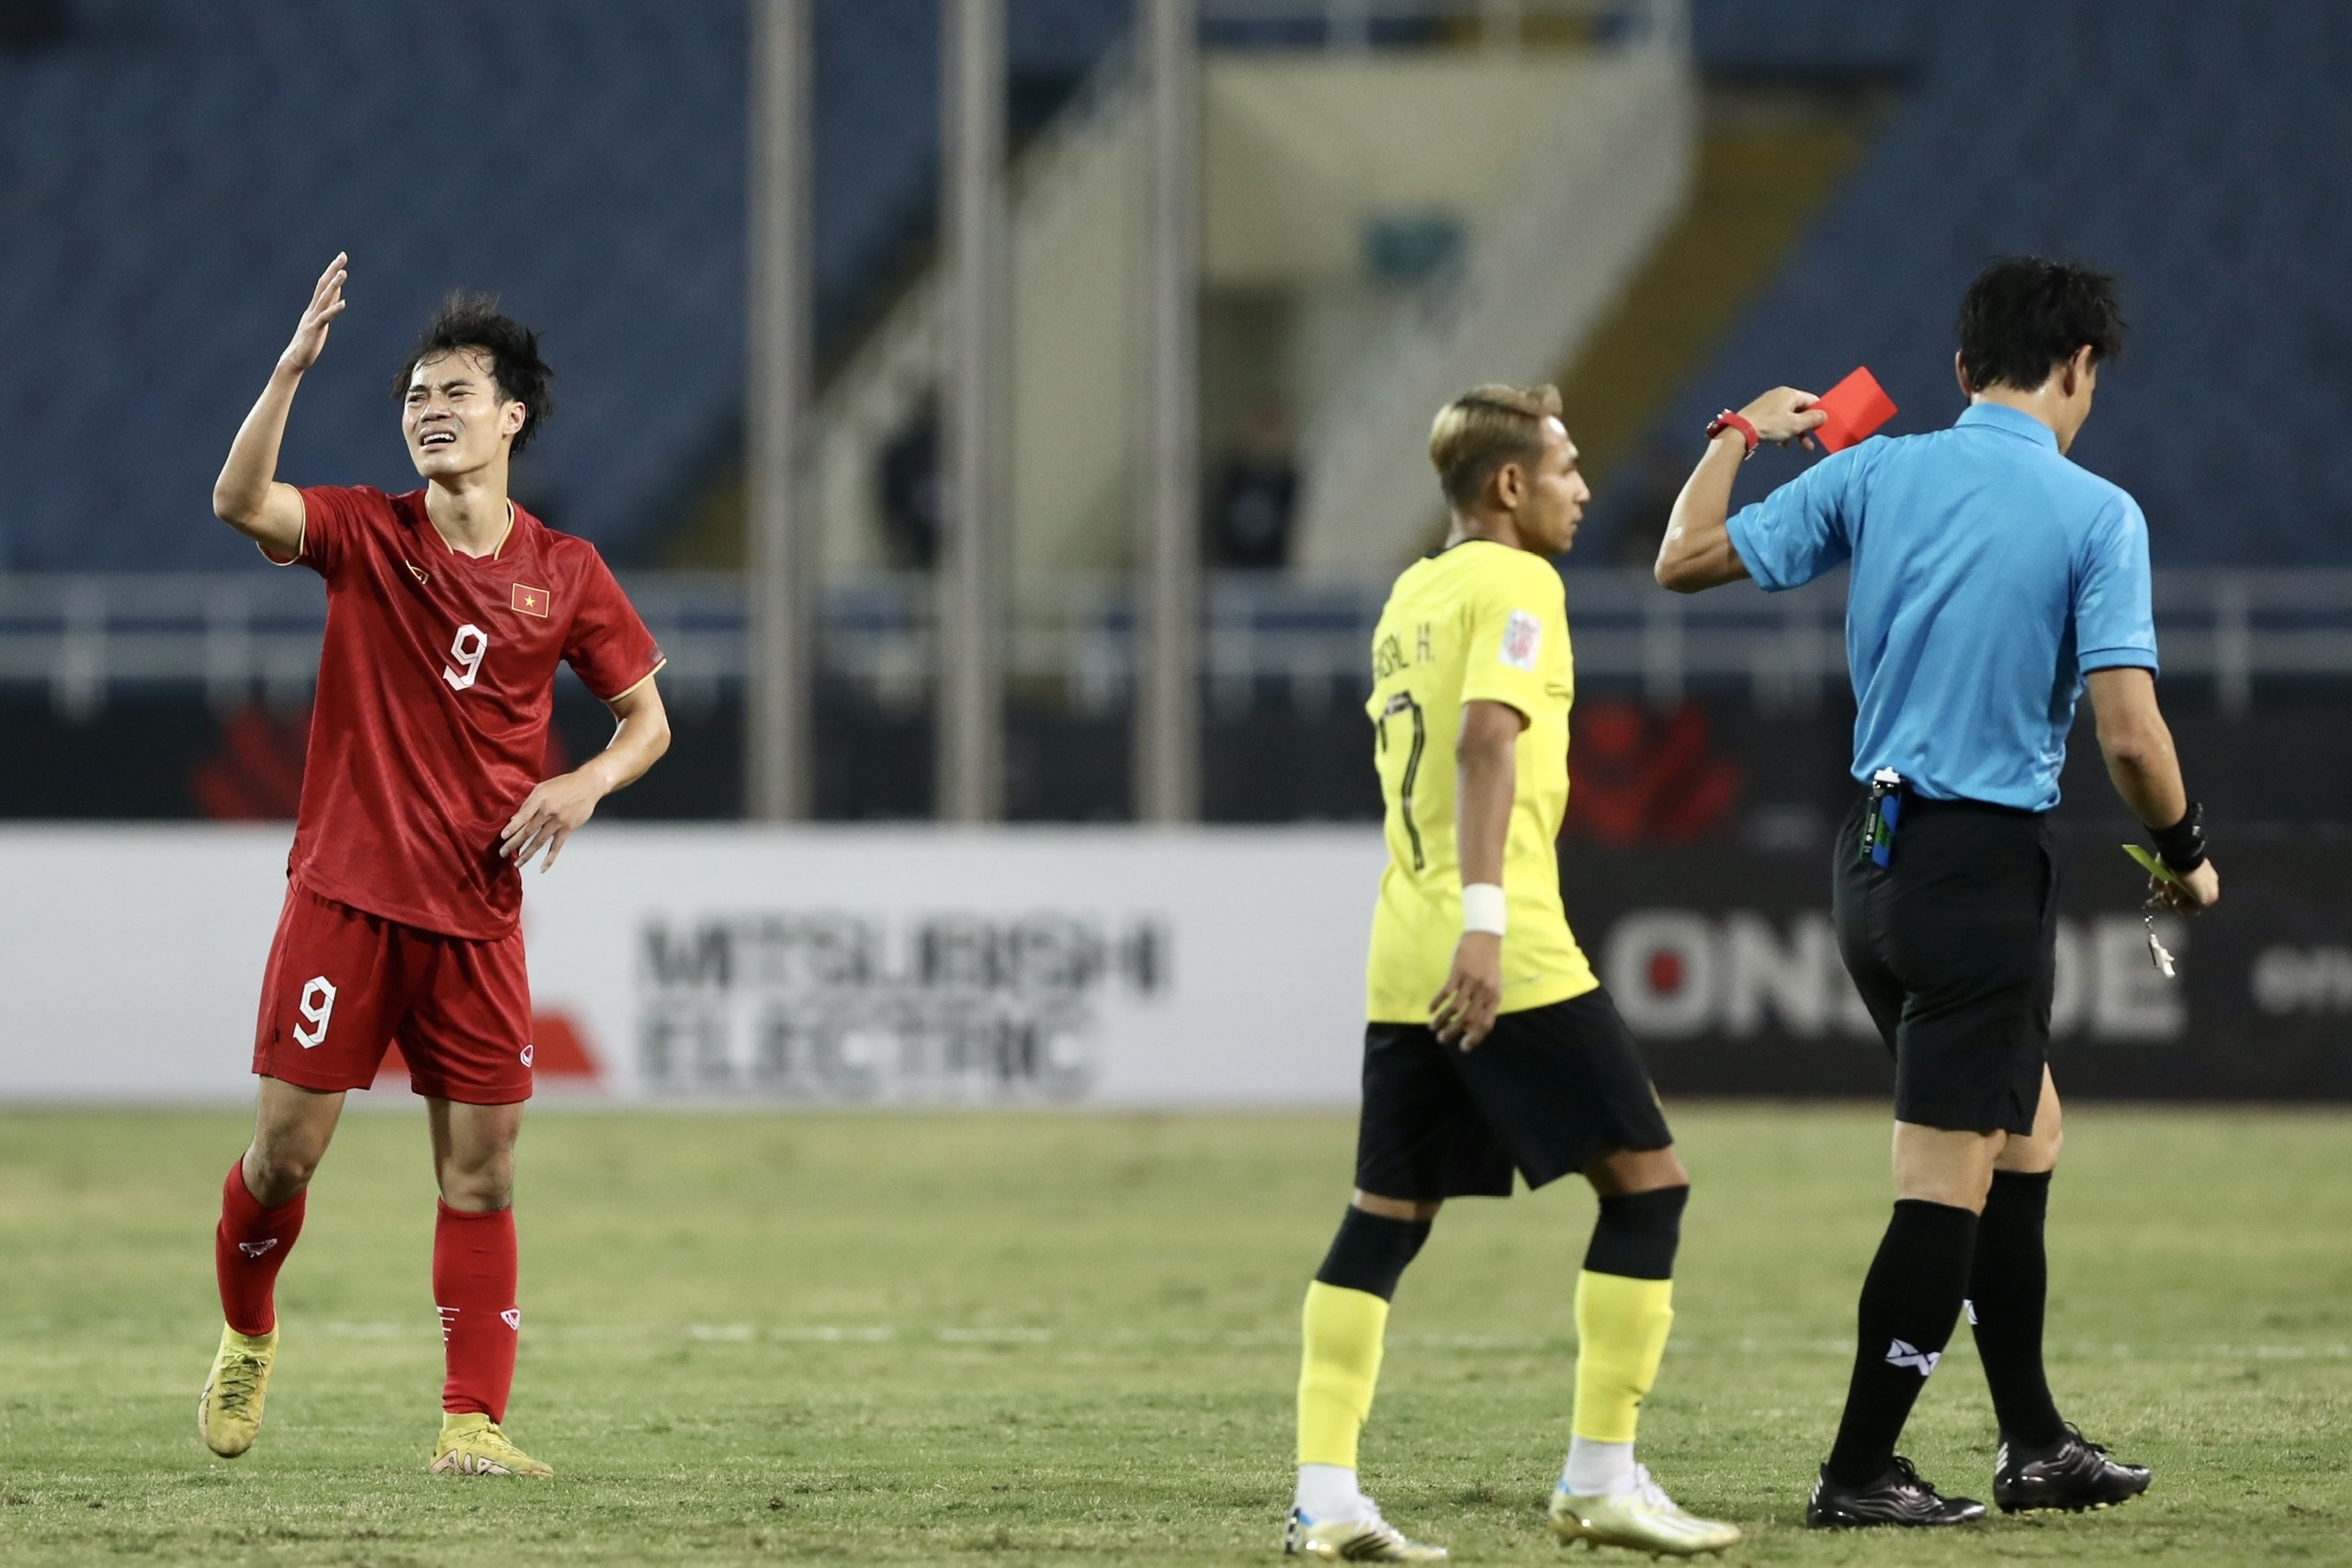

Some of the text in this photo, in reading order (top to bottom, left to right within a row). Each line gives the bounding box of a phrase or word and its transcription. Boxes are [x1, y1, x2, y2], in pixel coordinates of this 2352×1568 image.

[443, 624, 488, 691] 9
[1379, 689, 1425, 871] 7
[640, 911, 1171, 996] MITSUBISHI
[292, 975, 337, 1049] 9
[640, 1003, 1097, 1095] ELECTRIC
